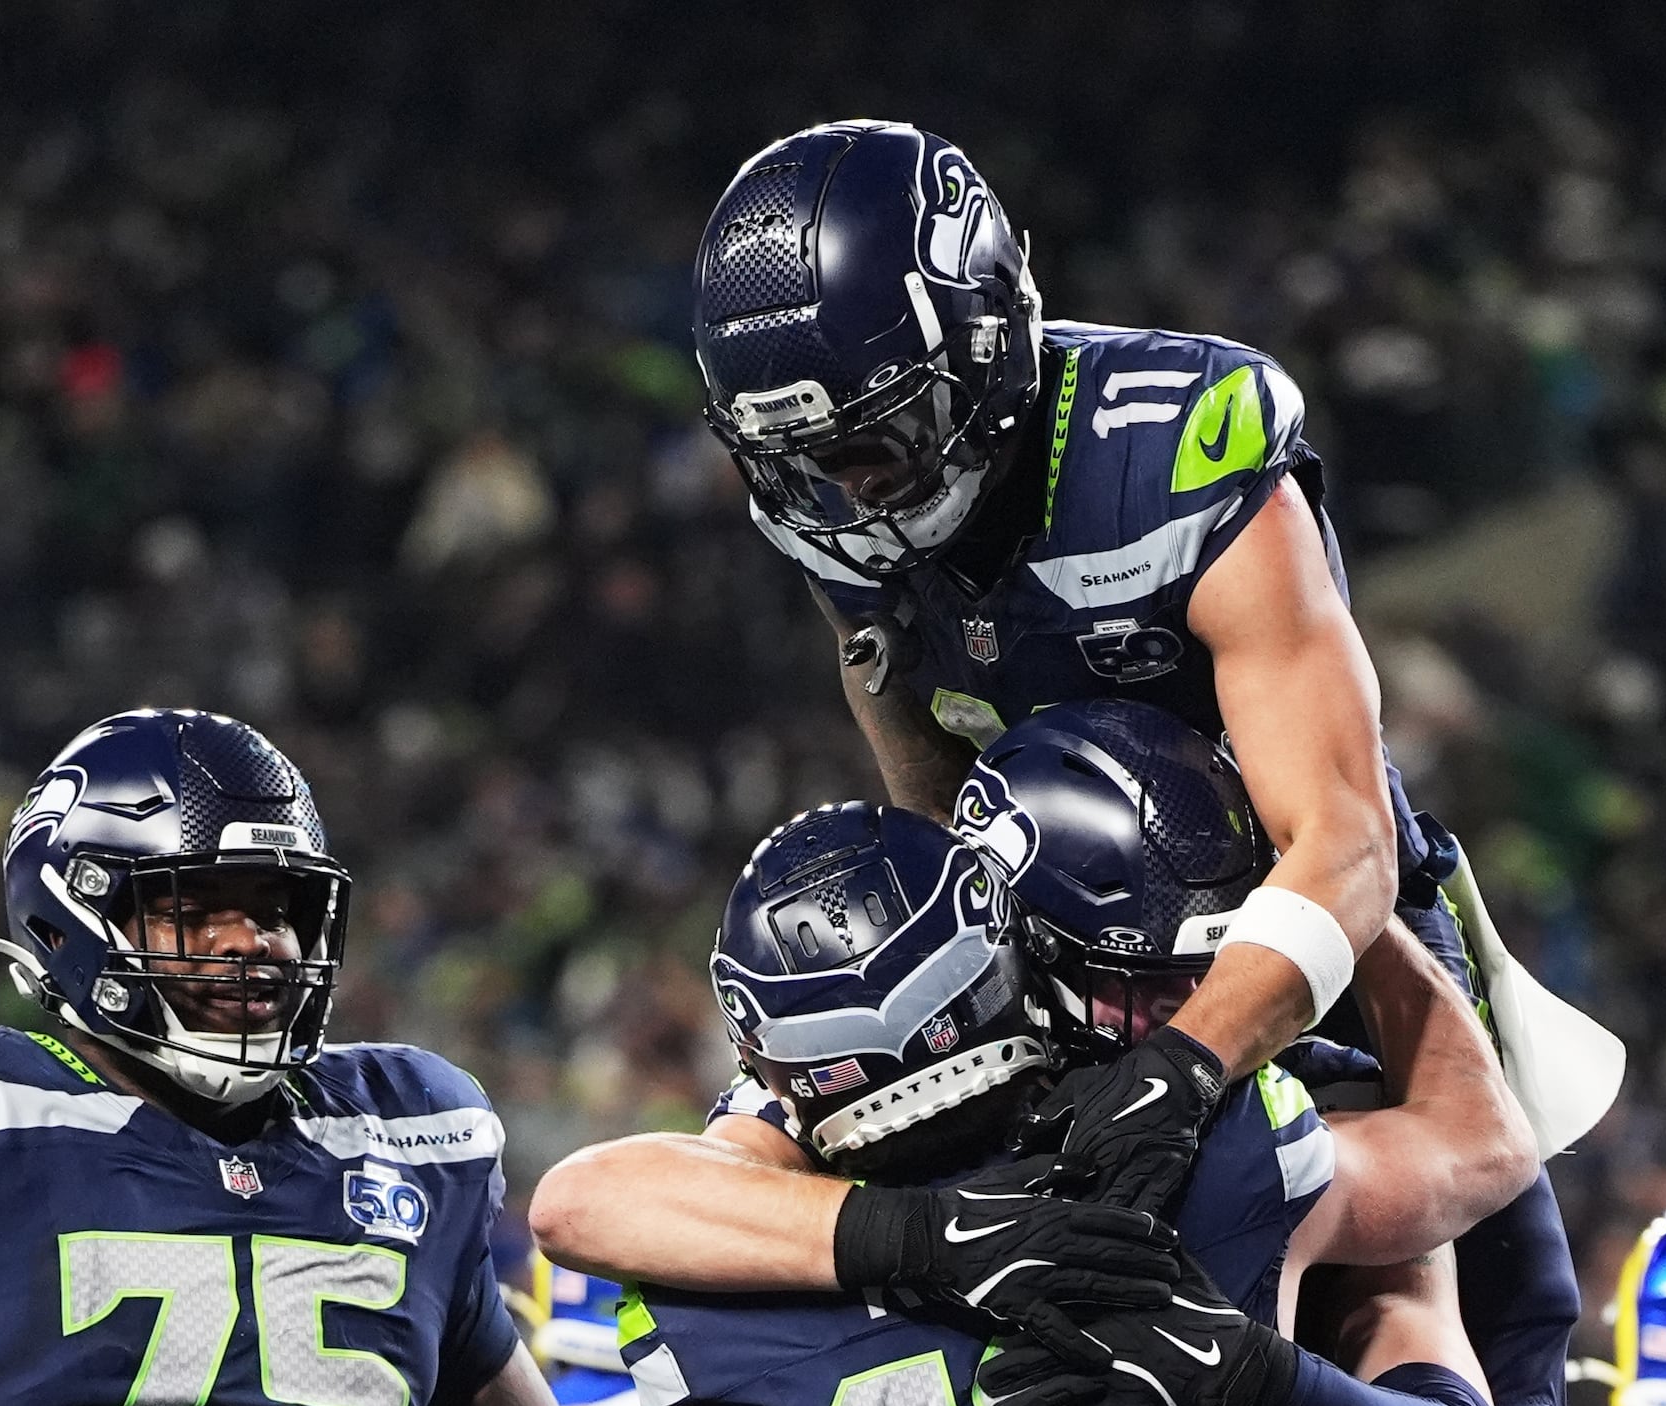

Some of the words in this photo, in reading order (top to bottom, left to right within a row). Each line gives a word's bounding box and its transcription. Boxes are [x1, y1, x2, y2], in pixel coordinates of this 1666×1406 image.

[1091, 369, 1203, 440] 11
[251, 828, 297, 843] SEAHAWKS
[1099, 939, 1155, 952] OAKLEY
[931, 1029, 956, 1050] NFL
[790, 1077, 815, 1098] 45
[853, 1053, 985, 1120] SEATTLE
[230, 1173, 258, 1191] NFL
[347, 1173, 428, 1231] 50
